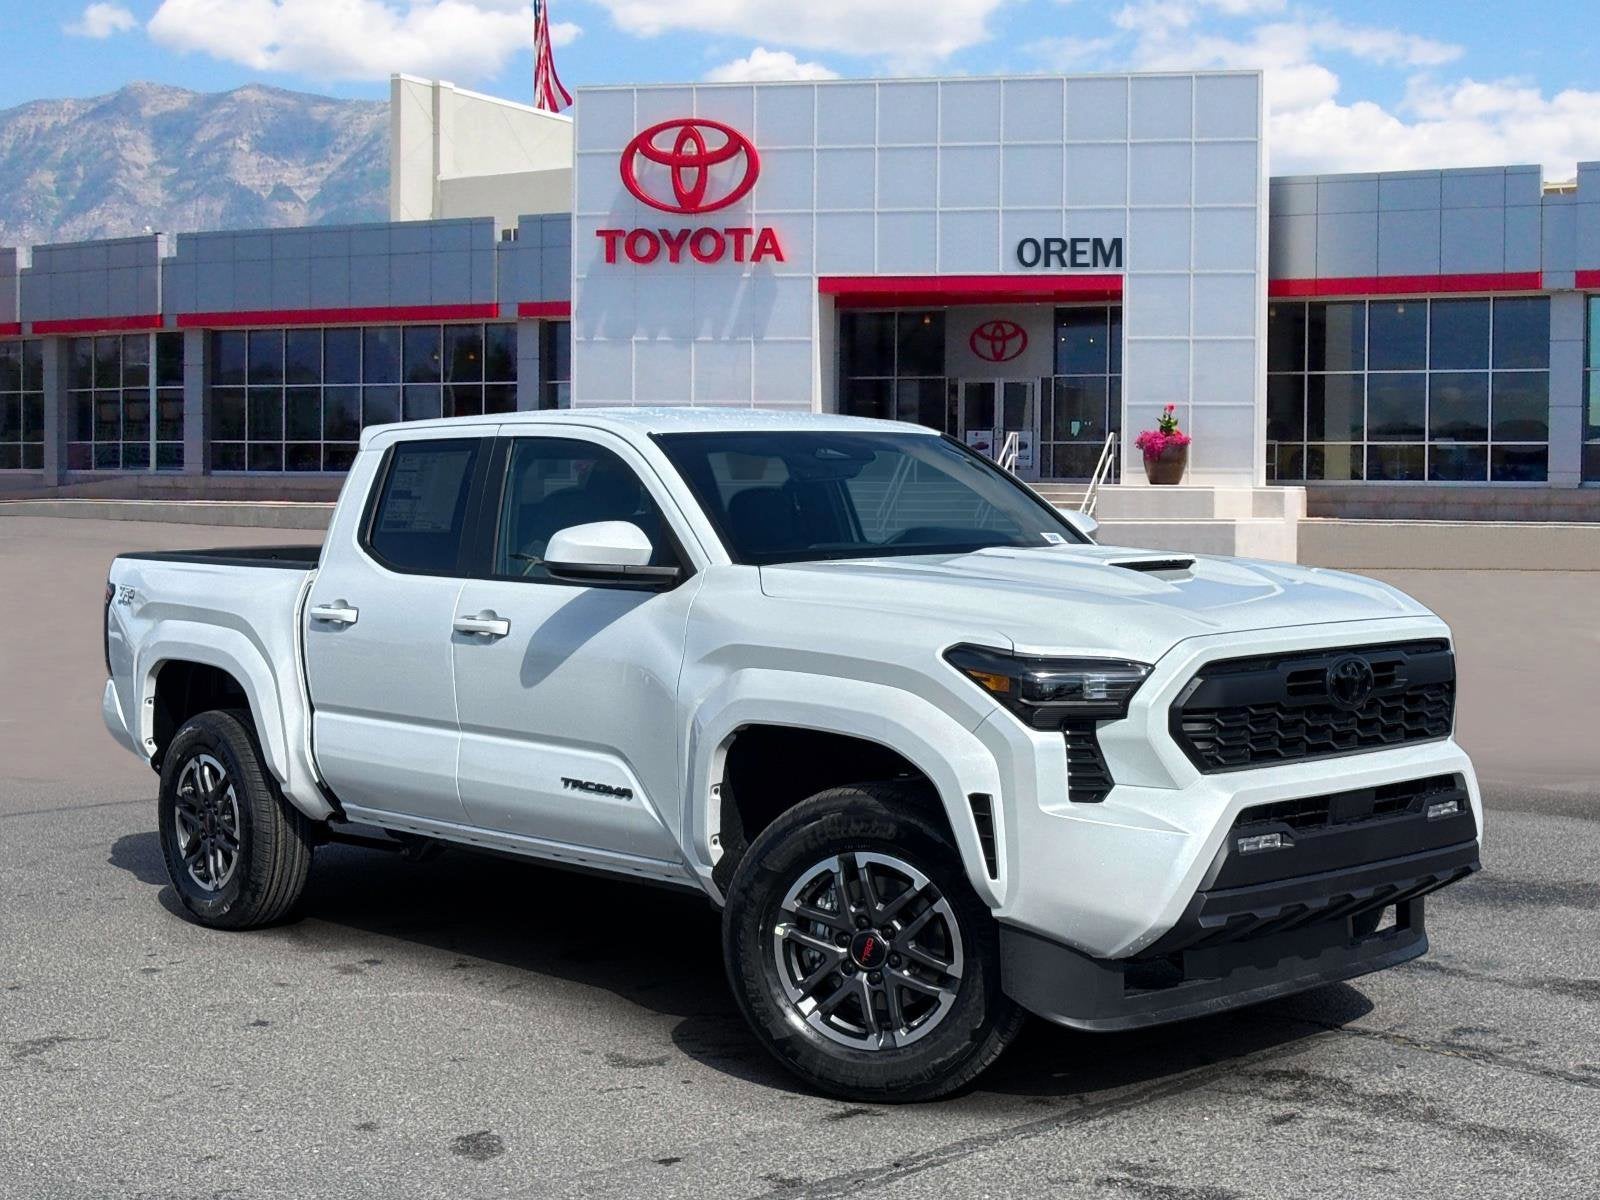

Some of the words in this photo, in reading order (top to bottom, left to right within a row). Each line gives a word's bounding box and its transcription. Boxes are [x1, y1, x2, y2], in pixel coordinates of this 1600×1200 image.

[596, 227, 784, 264] TOYOTA
[1017, 237, 1122, 268] OREM
[561, 776, 633, 801] TACOMA
[861, 936, 875, 963] TRD
